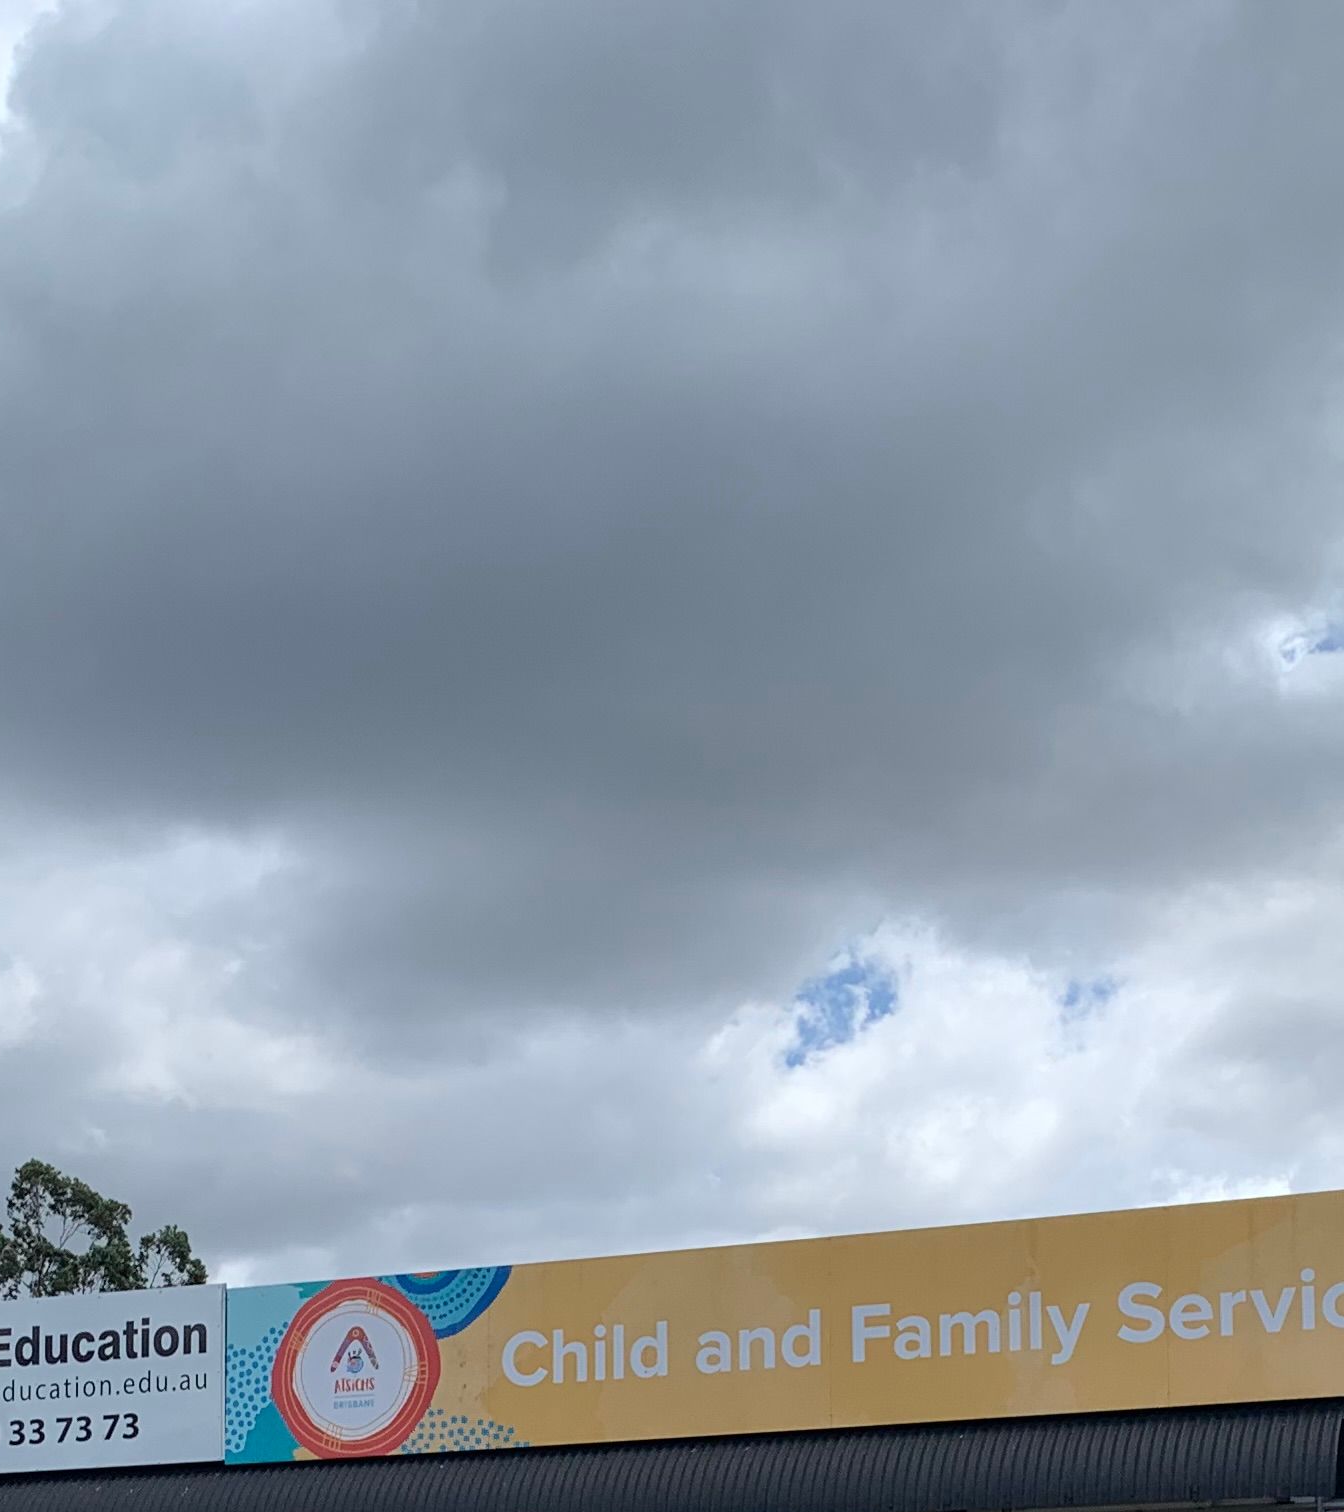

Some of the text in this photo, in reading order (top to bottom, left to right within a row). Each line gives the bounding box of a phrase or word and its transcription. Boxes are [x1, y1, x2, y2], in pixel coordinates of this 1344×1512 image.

[502, 1320, 669, 1388] Child
[694, 1308, 822, 1377] and
[851, 1290, 1091, 1366] Family
[8, 1418, 46, 1447] 33
[55, 1415, 93, 1444] 73
[102, 1412, 140, 1441] 73
